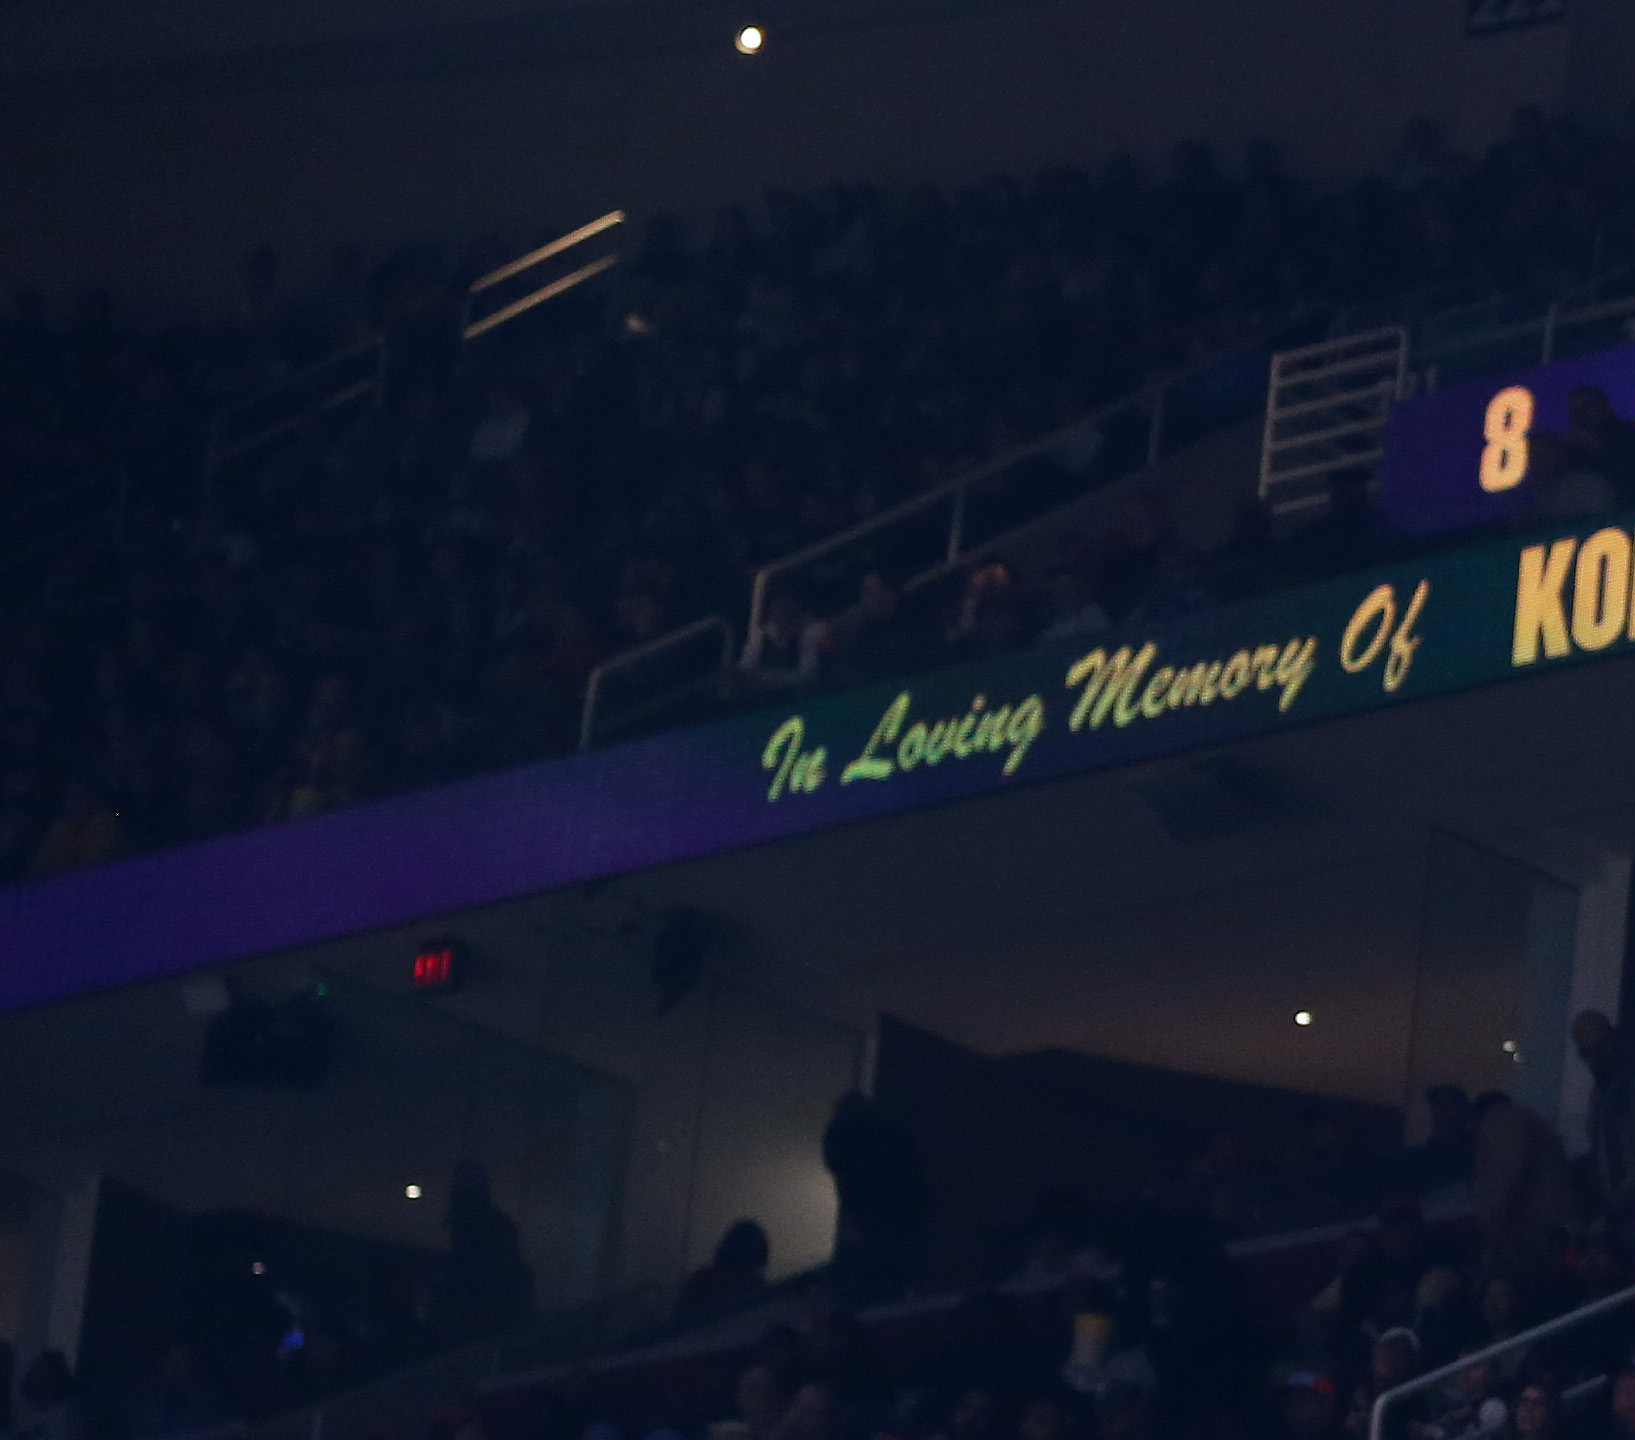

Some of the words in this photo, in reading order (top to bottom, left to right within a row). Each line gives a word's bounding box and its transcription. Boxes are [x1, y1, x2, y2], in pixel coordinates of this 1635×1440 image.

[1479, 384, 1534, 493] 8
[761, 716, 829, 801] In
[840, 690, 1046, 777] Loving
[1065, 640, 1318, 733] Memory
[1339, 578, 1430, 692] Of
